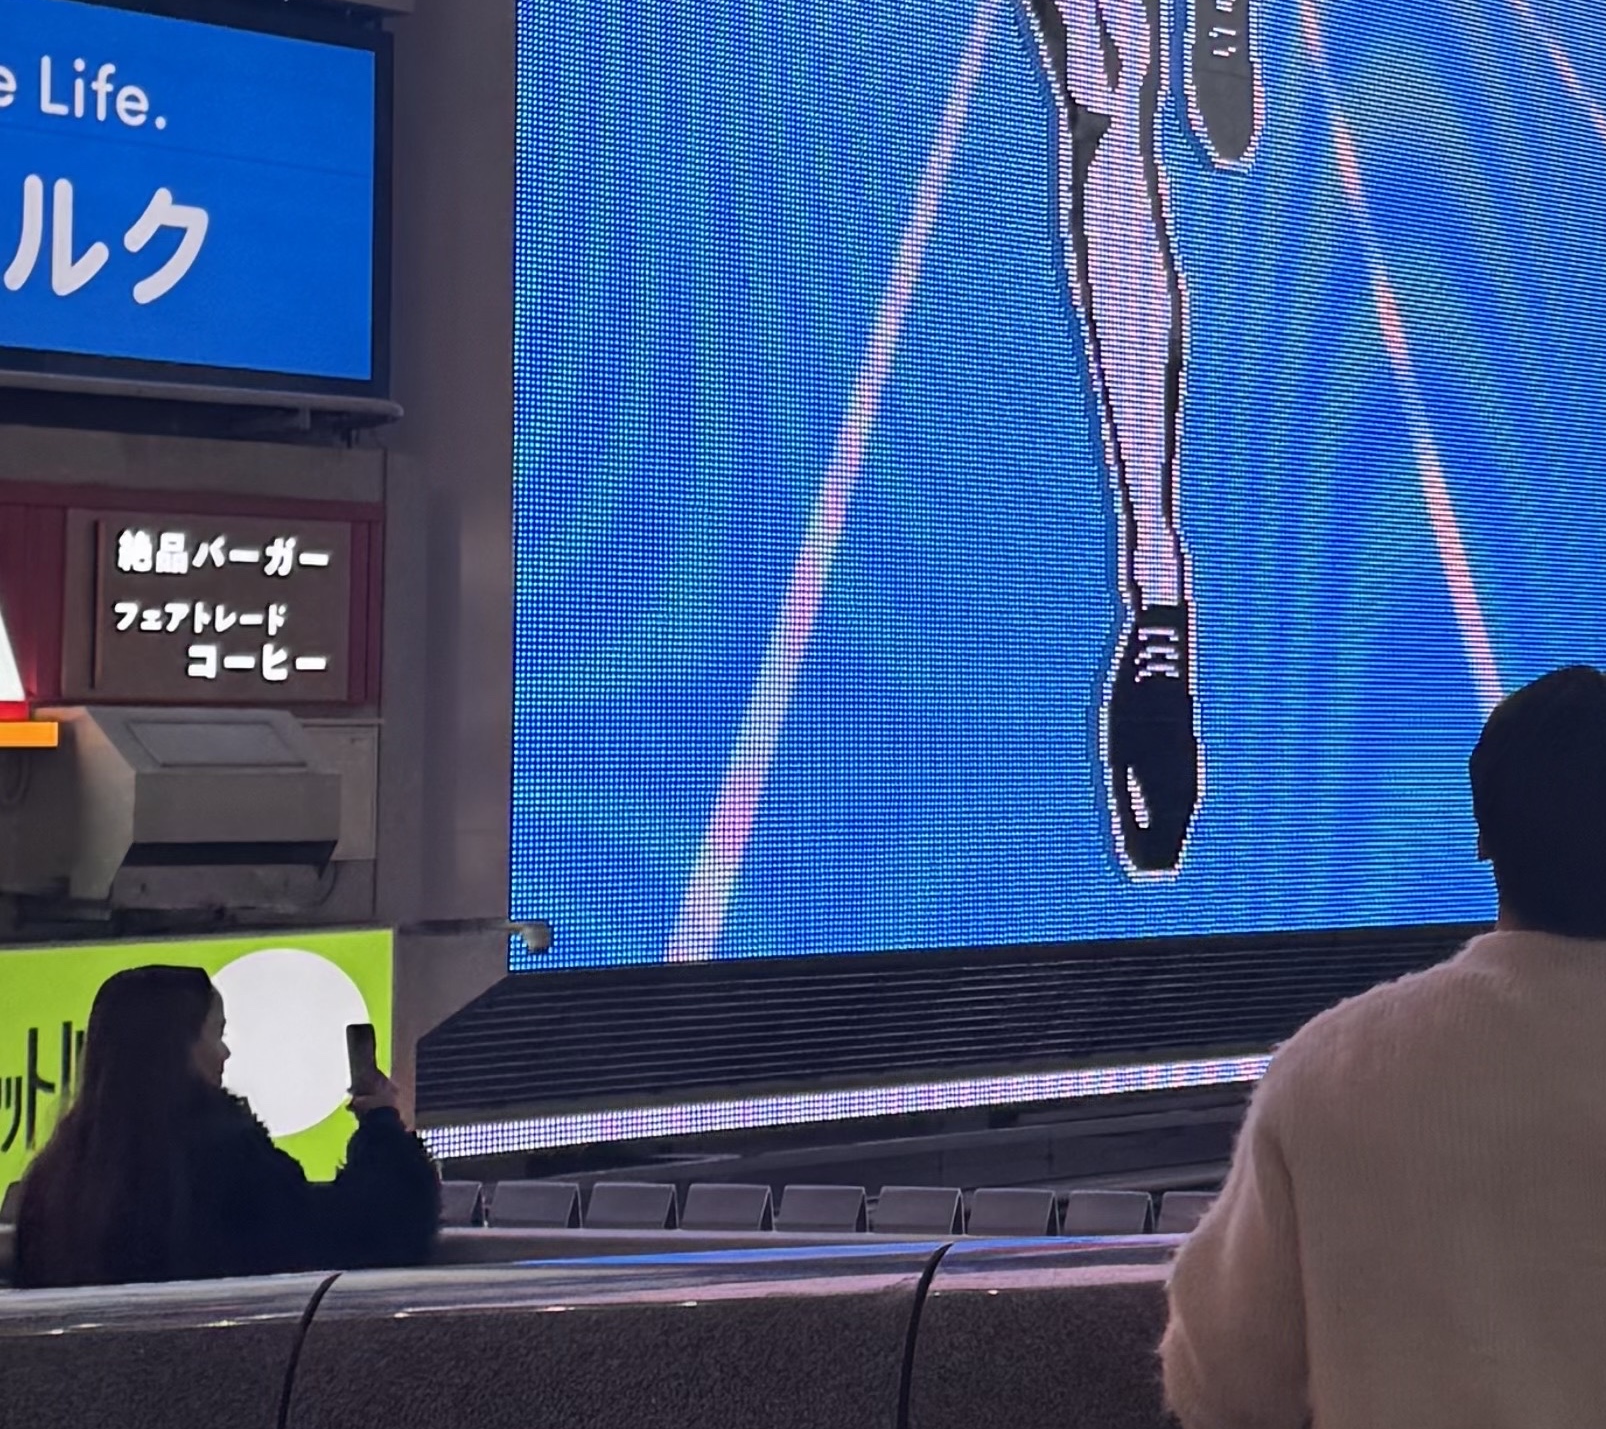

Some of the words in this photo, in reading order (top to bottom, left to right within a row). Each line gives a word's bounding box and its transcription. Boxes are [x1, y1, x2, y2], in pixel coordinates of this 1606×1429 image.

[40, 55, 167, 129] Life.
[4, 174, 209, 304] ルク
[118, 529, 330, 577] 絶品バーガー
[114, 602, 288, 636] フェアトレード
[188, 643, 327, 681] コーヒー
